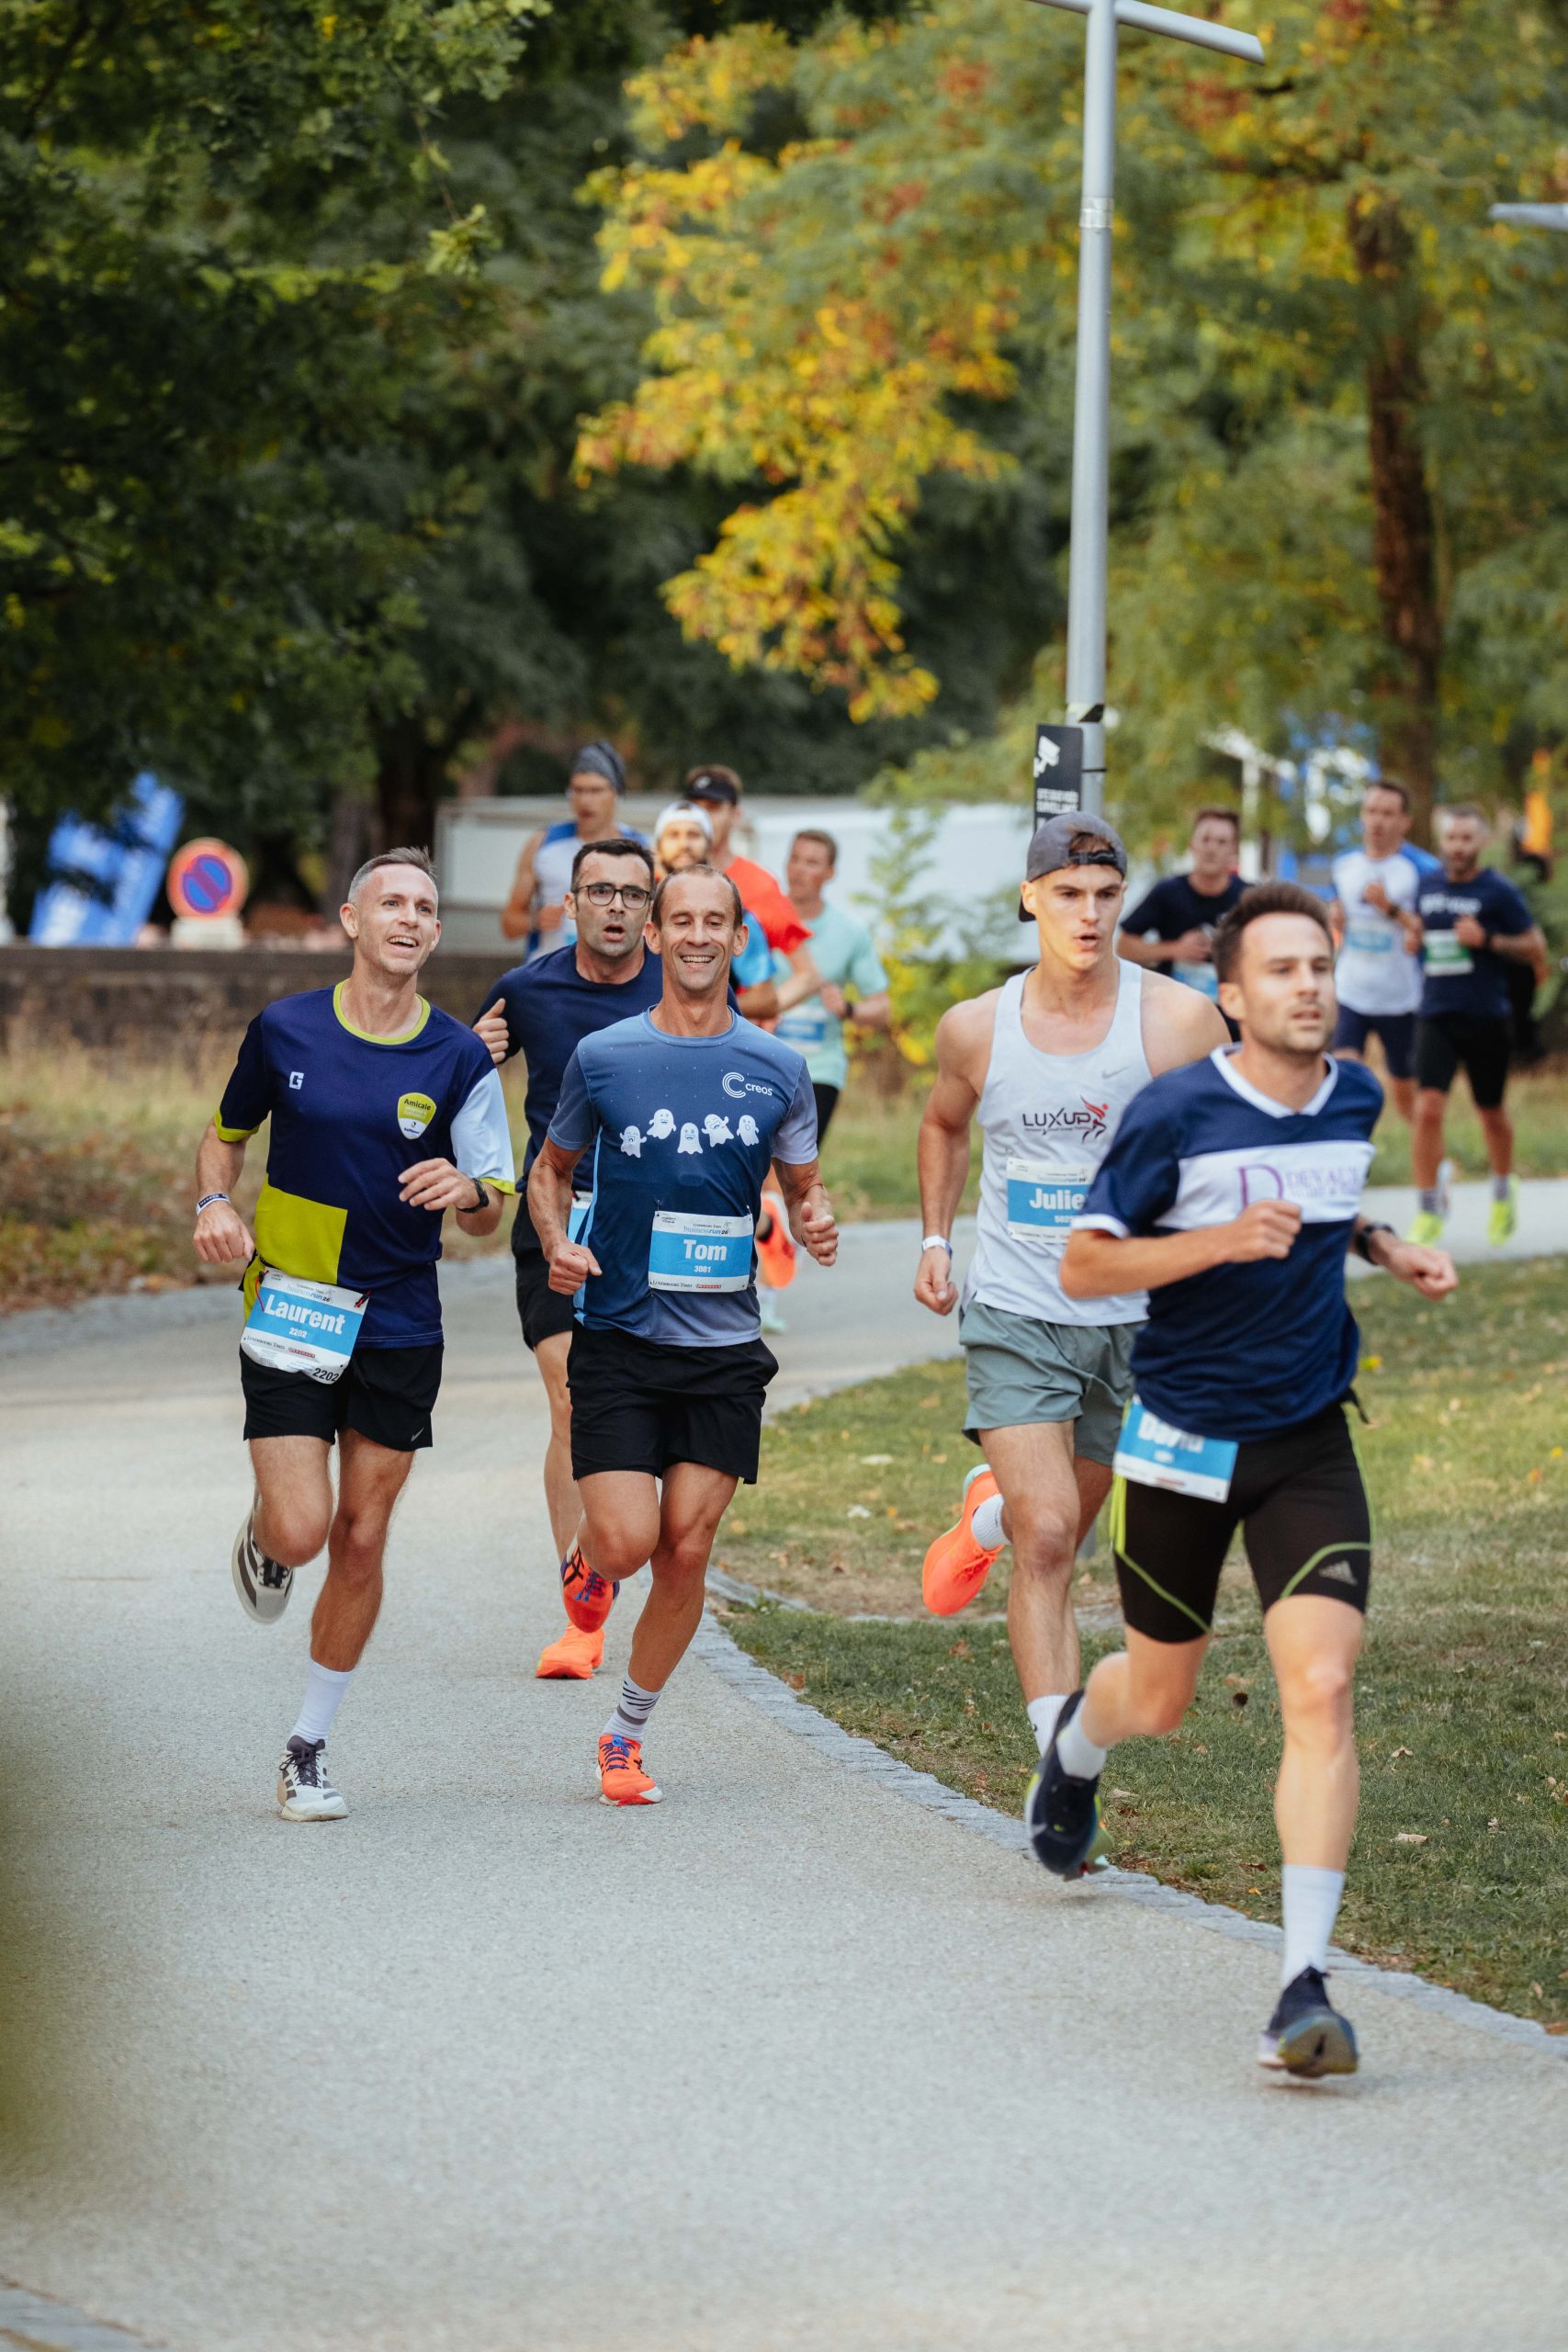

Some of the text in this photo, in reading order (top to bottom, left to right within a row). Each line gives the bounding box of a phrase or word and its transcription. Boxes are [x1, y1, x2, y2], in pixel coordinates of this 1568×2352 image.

[745, 1083, 773, 1096] creos
[403, 1098, 431, 1111] Amicale
[1022, 1107, 1091, 1128] LUXUP
[1029, 1188, 1088, 1210] Julie
[683, 1239, 728, 1261] Tom
[694, 1265, 711, 1273] 3081
[264, 1294, 345, 1335] Laurent
[288, 1327, 308, 1339] 2202
[312, 1367, 340, 1382] 2202
